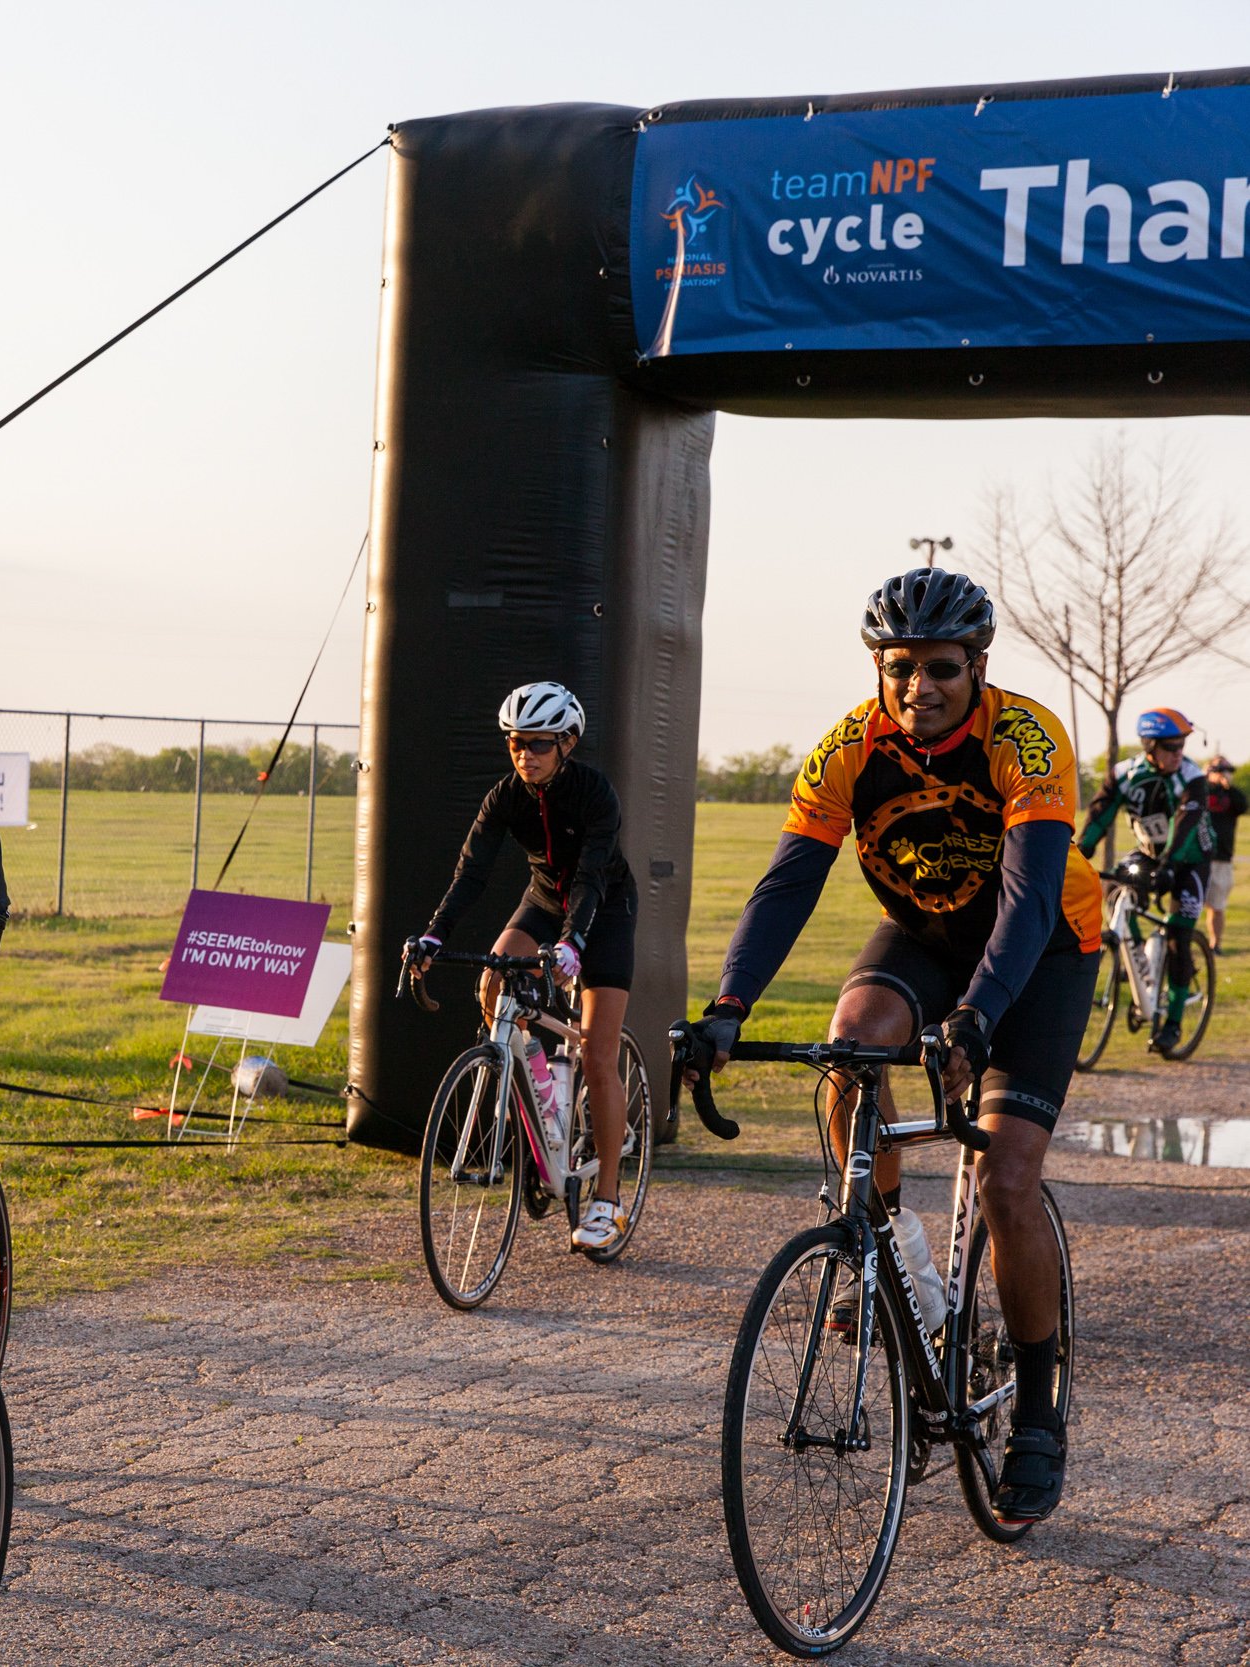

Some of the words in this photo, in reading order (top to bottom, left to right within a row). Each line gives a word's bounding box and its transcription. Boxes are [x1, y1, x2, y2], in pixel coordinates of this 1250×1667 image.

[770, 157, 937, 201] teamNPF
[767, 203, 924, 266] cycle
[846, 268, 924, 284] NOVARTIS
[801, 710, 871, 789] Cheeto
[181, 948, 207, 964] I'M
[207, 951, 233, 967] ON
[234, 954, 261, 971] MY
[263, 959, 301, 976] WAY
[186, 930, 307, 958] #SEEMEtoknow
[888, 1235, 942, 1381] cannondale
